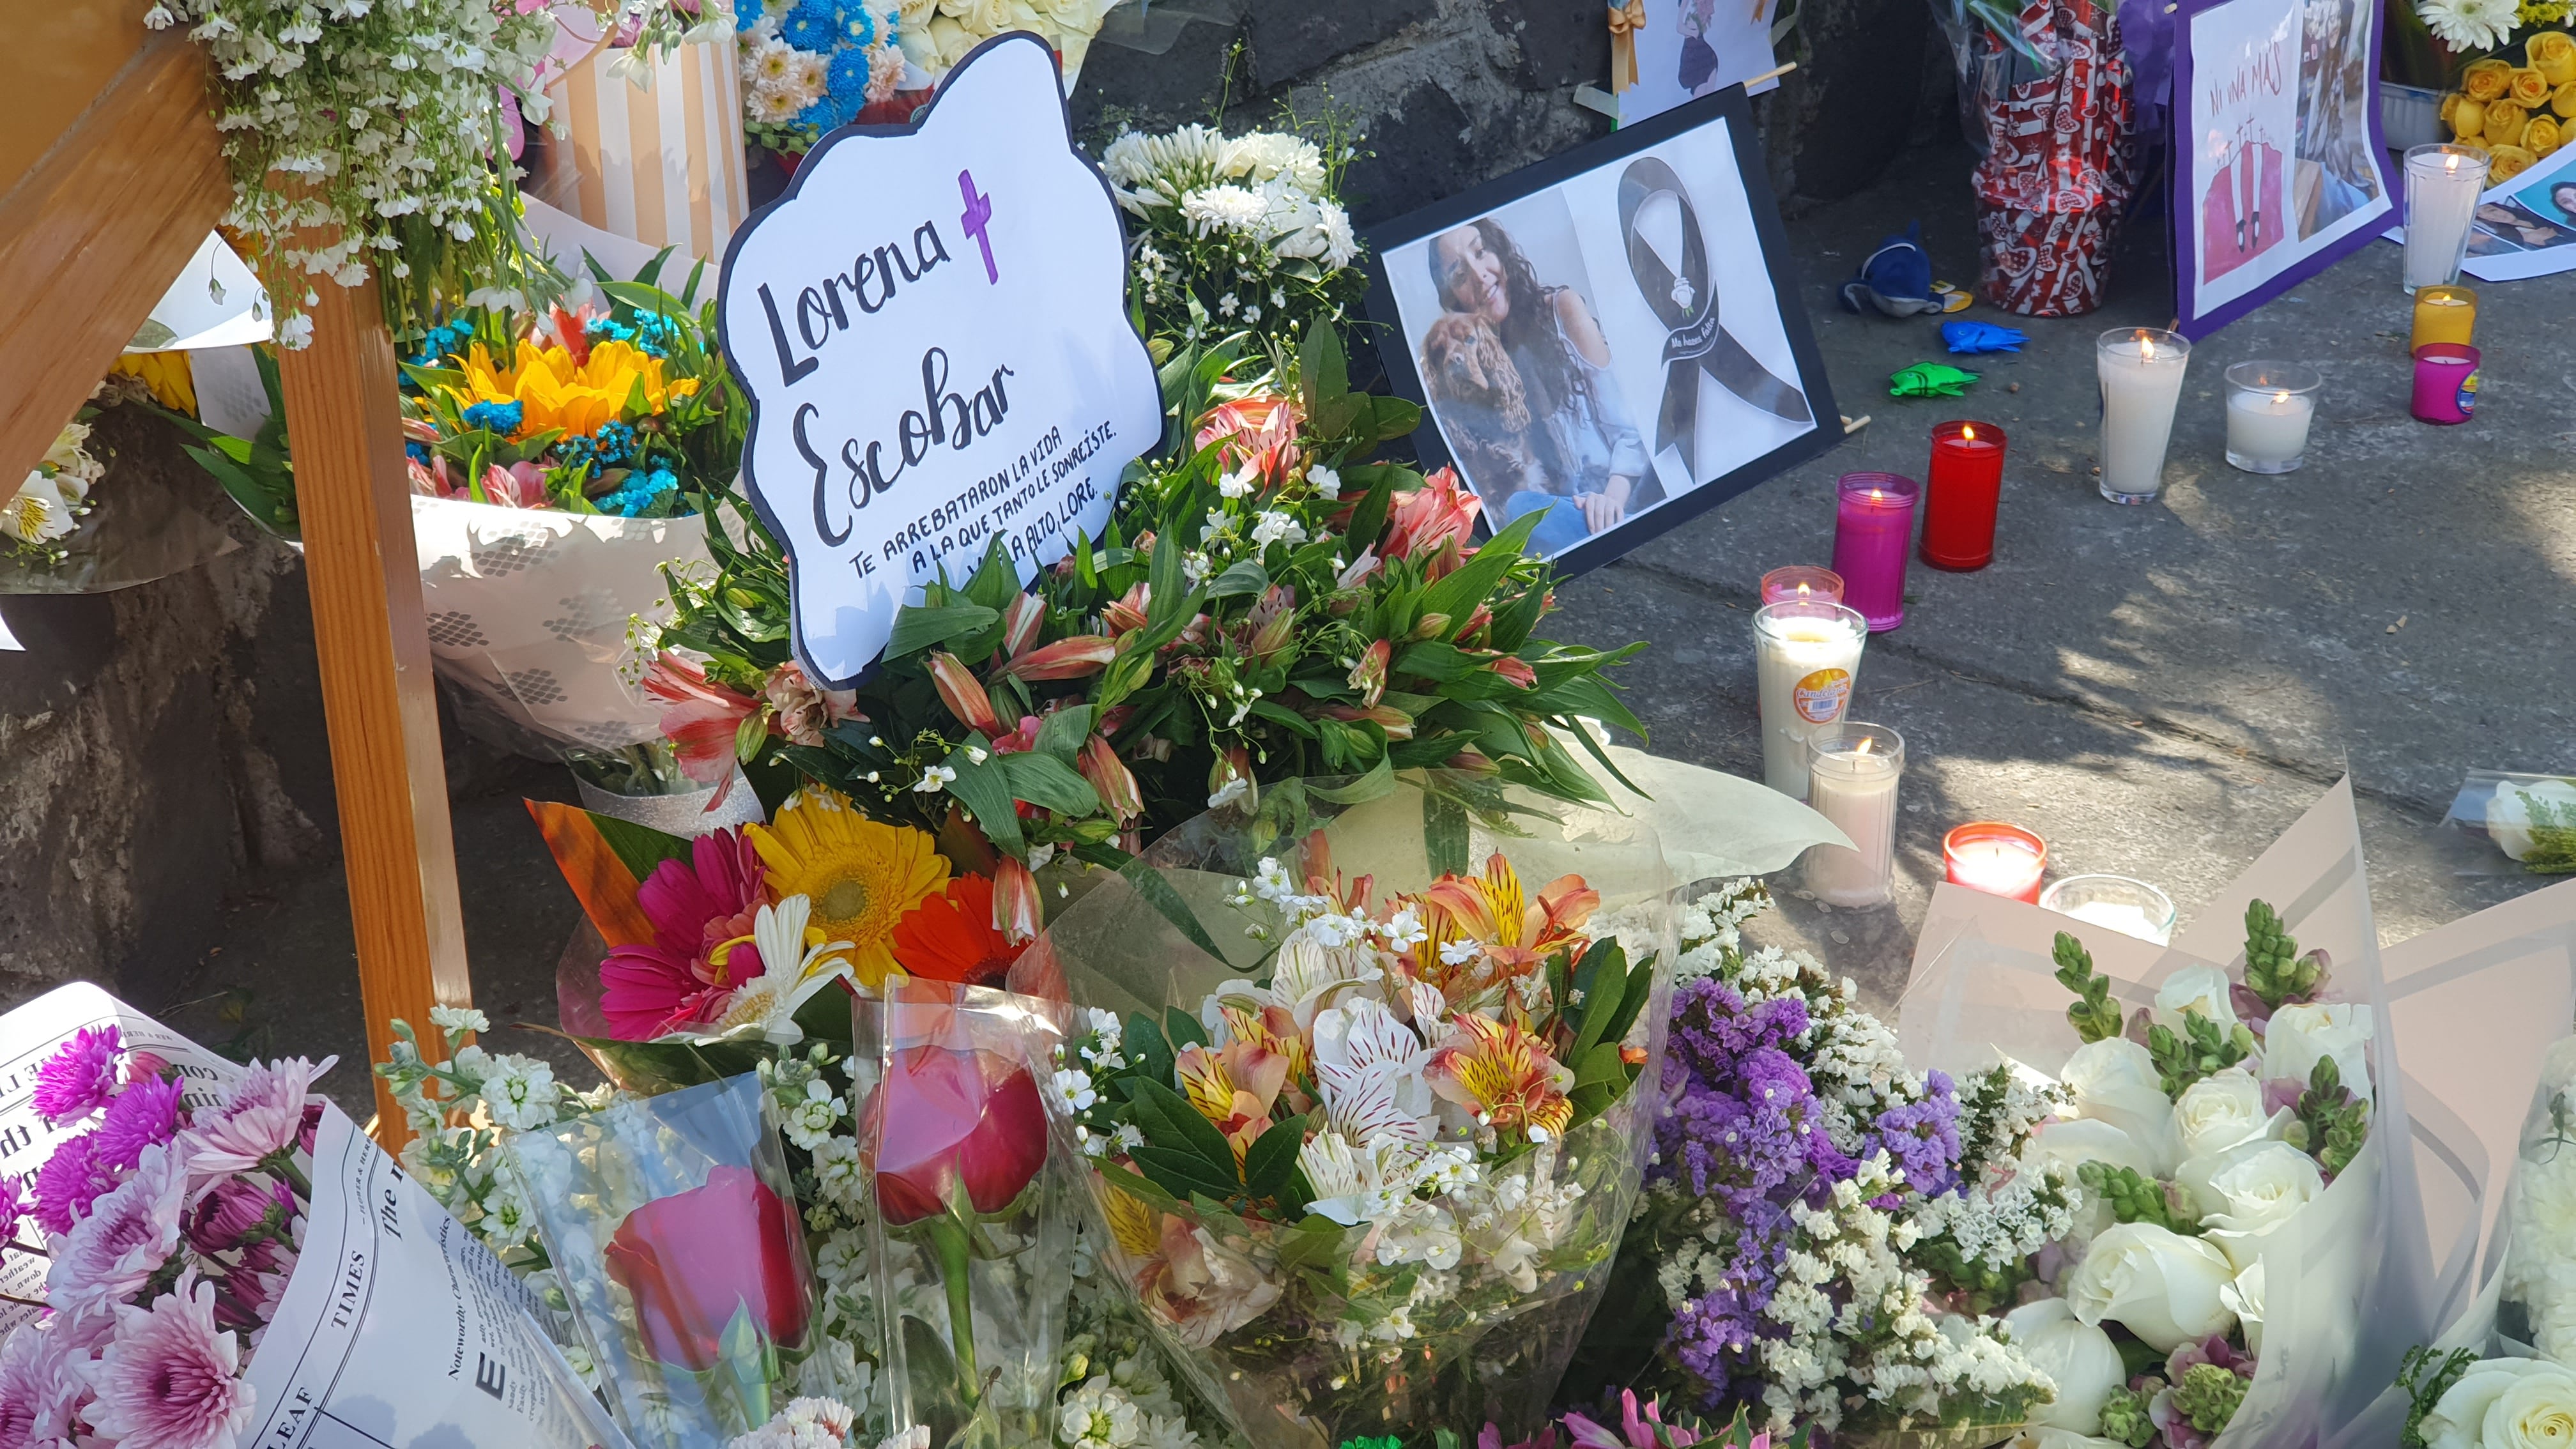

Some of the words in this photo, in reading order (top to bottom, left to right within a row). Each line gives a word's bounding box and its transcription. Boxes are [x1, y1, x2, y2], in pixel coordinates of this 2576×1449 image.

[2210, 79, 2223, 118] NI
[2227, 66, 2246, 105] UNA
[757, 220, 951, 387] Lorena
[793, 347, 1013, 547] Escobar
[849, 551, 877, 578] TE
[883, 469, 1010, 561] ARREBATARON
[1012, 454, 1030, 483] LA
[1030, 425, 1062, 467] VIDA
[912, 551, 926, 574] A
[930, 536, 954, 560] LA
[958, 514, 990, 548] QUE
[992, 484, 1035, 526] TANTO
[1036, 469, 1050, 494] LE
[1025, 511, 1061, 555] ALTO,
[1059, 477, 1098, 525] LORE.
[356, 1177, 365, 1215] FLOWER
[357, 1167, 364, 1176] &
[380, 1188, 403, 1242] The
[331, 1250, 365, 1331] TIMES
[438, 1215, 462, 1300] Characteristics
[448, 1301, 466, 1381] Noteworthy
[475, 1351, 505, 1401] E
